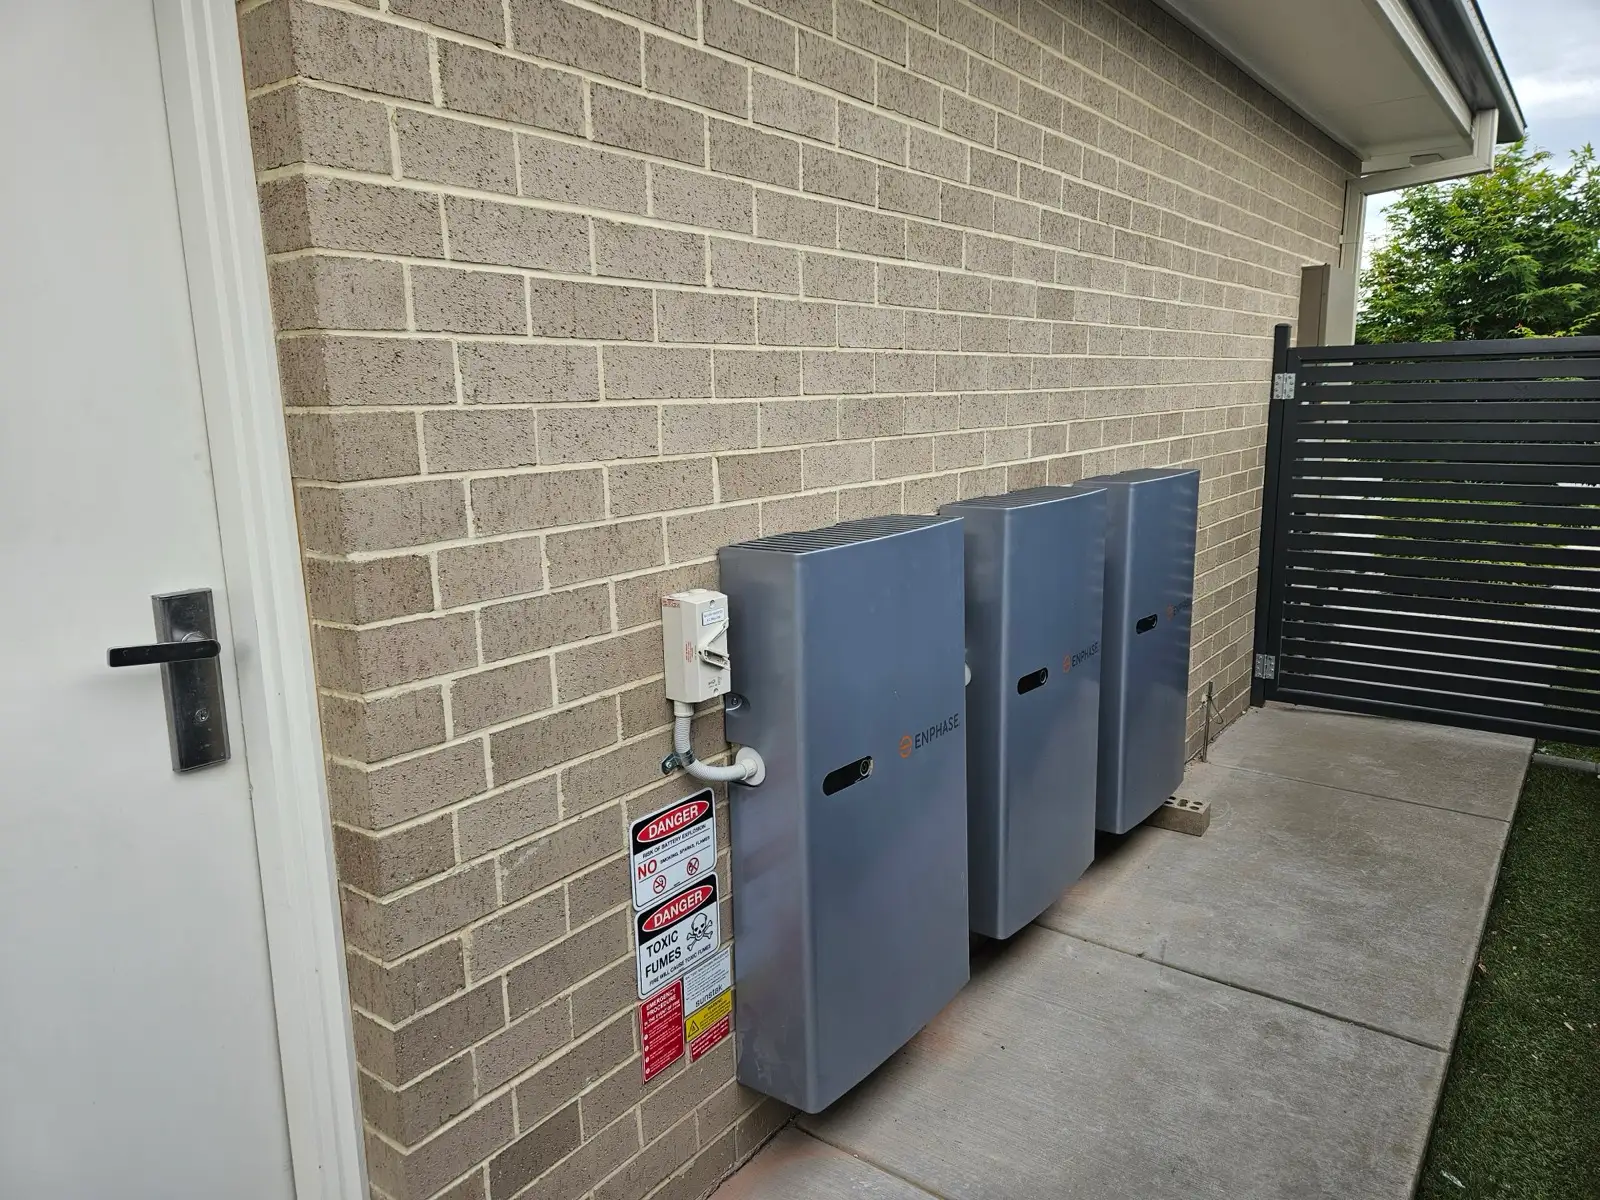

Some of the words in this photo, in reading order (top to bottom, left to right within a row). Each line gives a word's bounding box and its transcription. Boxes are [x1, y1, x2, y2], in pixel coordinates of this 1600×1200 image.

[914, 713, 959, 749] ENPHASE
[649, 805, 699, 839] DANGER
[643, 849, 654, 859] RISK
[654, 845, 661, 853] OF
[662, 836, 681, 850] BATTERY
[637, 859, 657, 880] NO
[653, 890, 703, 928] DANGER
[646, 930, 679, 958] TOXIC
[645, 946, 682, 978] FUMES
